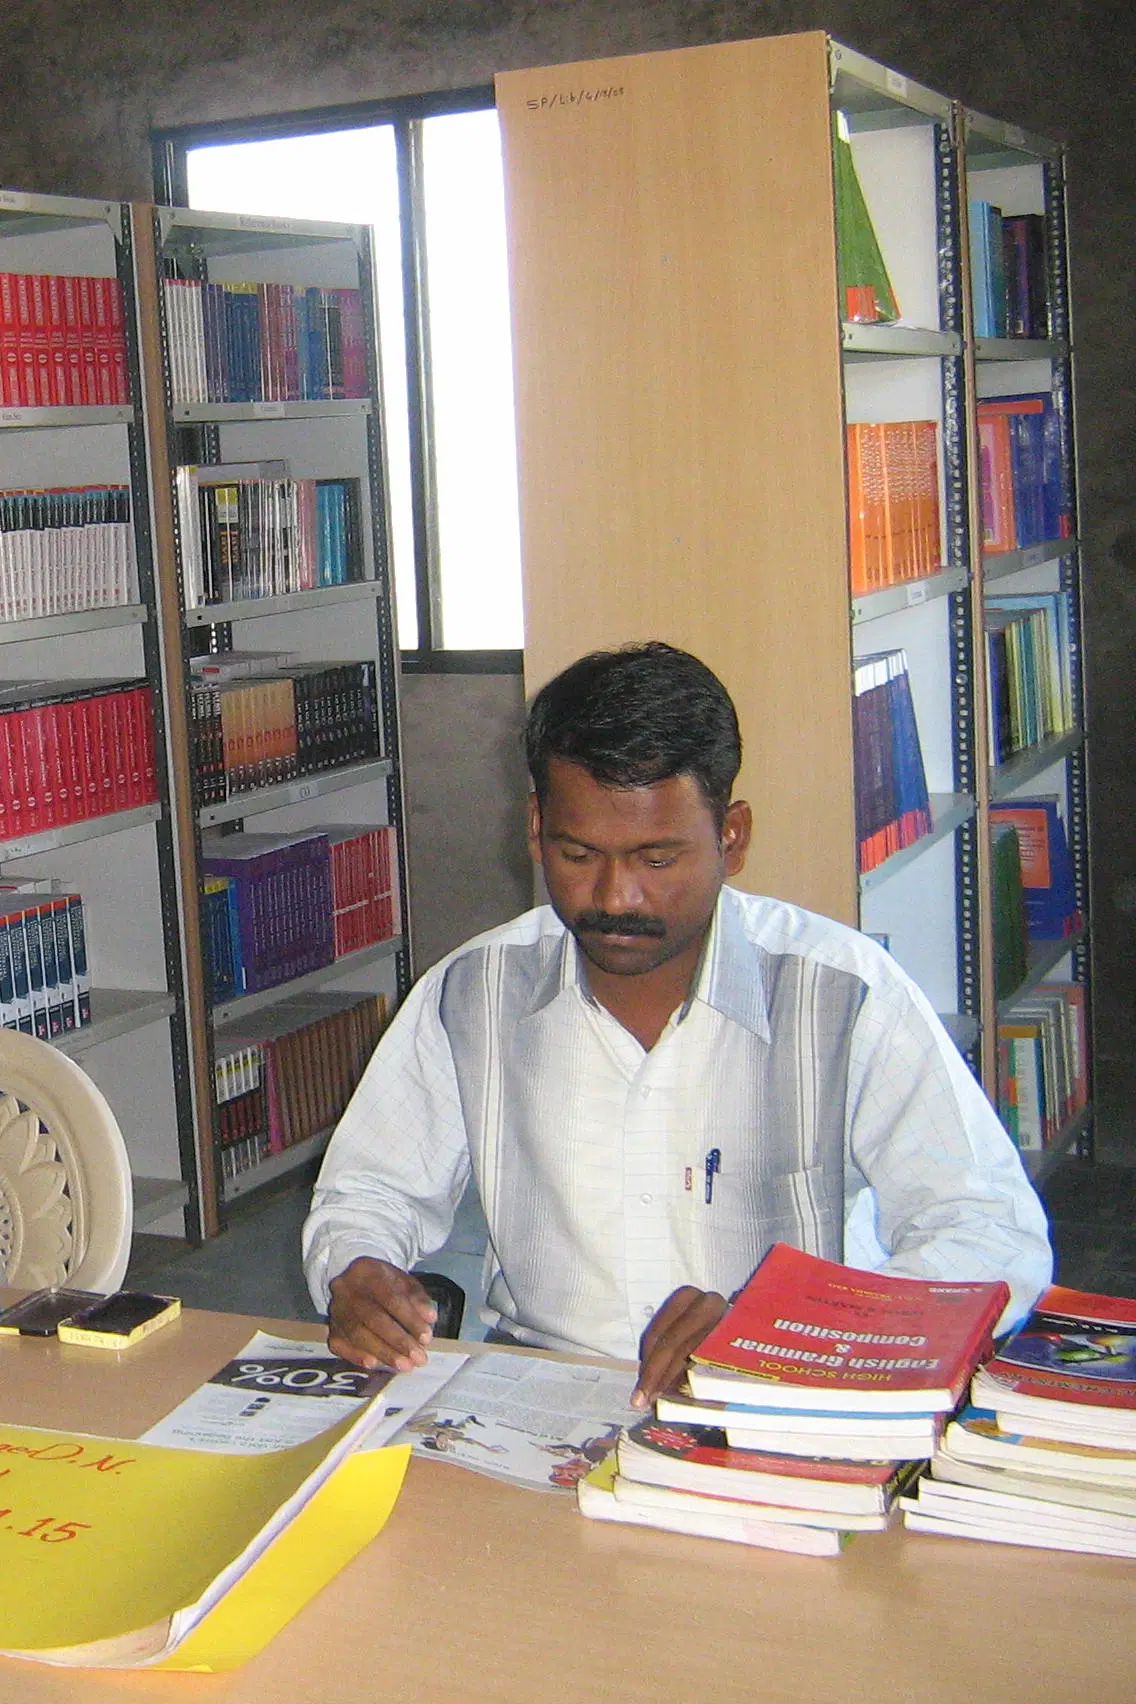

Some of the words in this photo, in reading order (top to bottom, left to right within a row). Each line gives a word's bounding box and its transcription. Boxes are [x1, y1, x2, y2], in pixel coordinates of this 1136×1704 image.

[773, 1318, 927, 1347] Composition
[729, 1336, 845, 1367] Grammar
[835, 1343, 852, 1356] &
[758, 1359, 838, 1380] SCHOOL
[847, 1356, 940, 1371] English
[231, 1363, 369, 1391] 30%
[841, 1371, 892, 1382] HIGH
